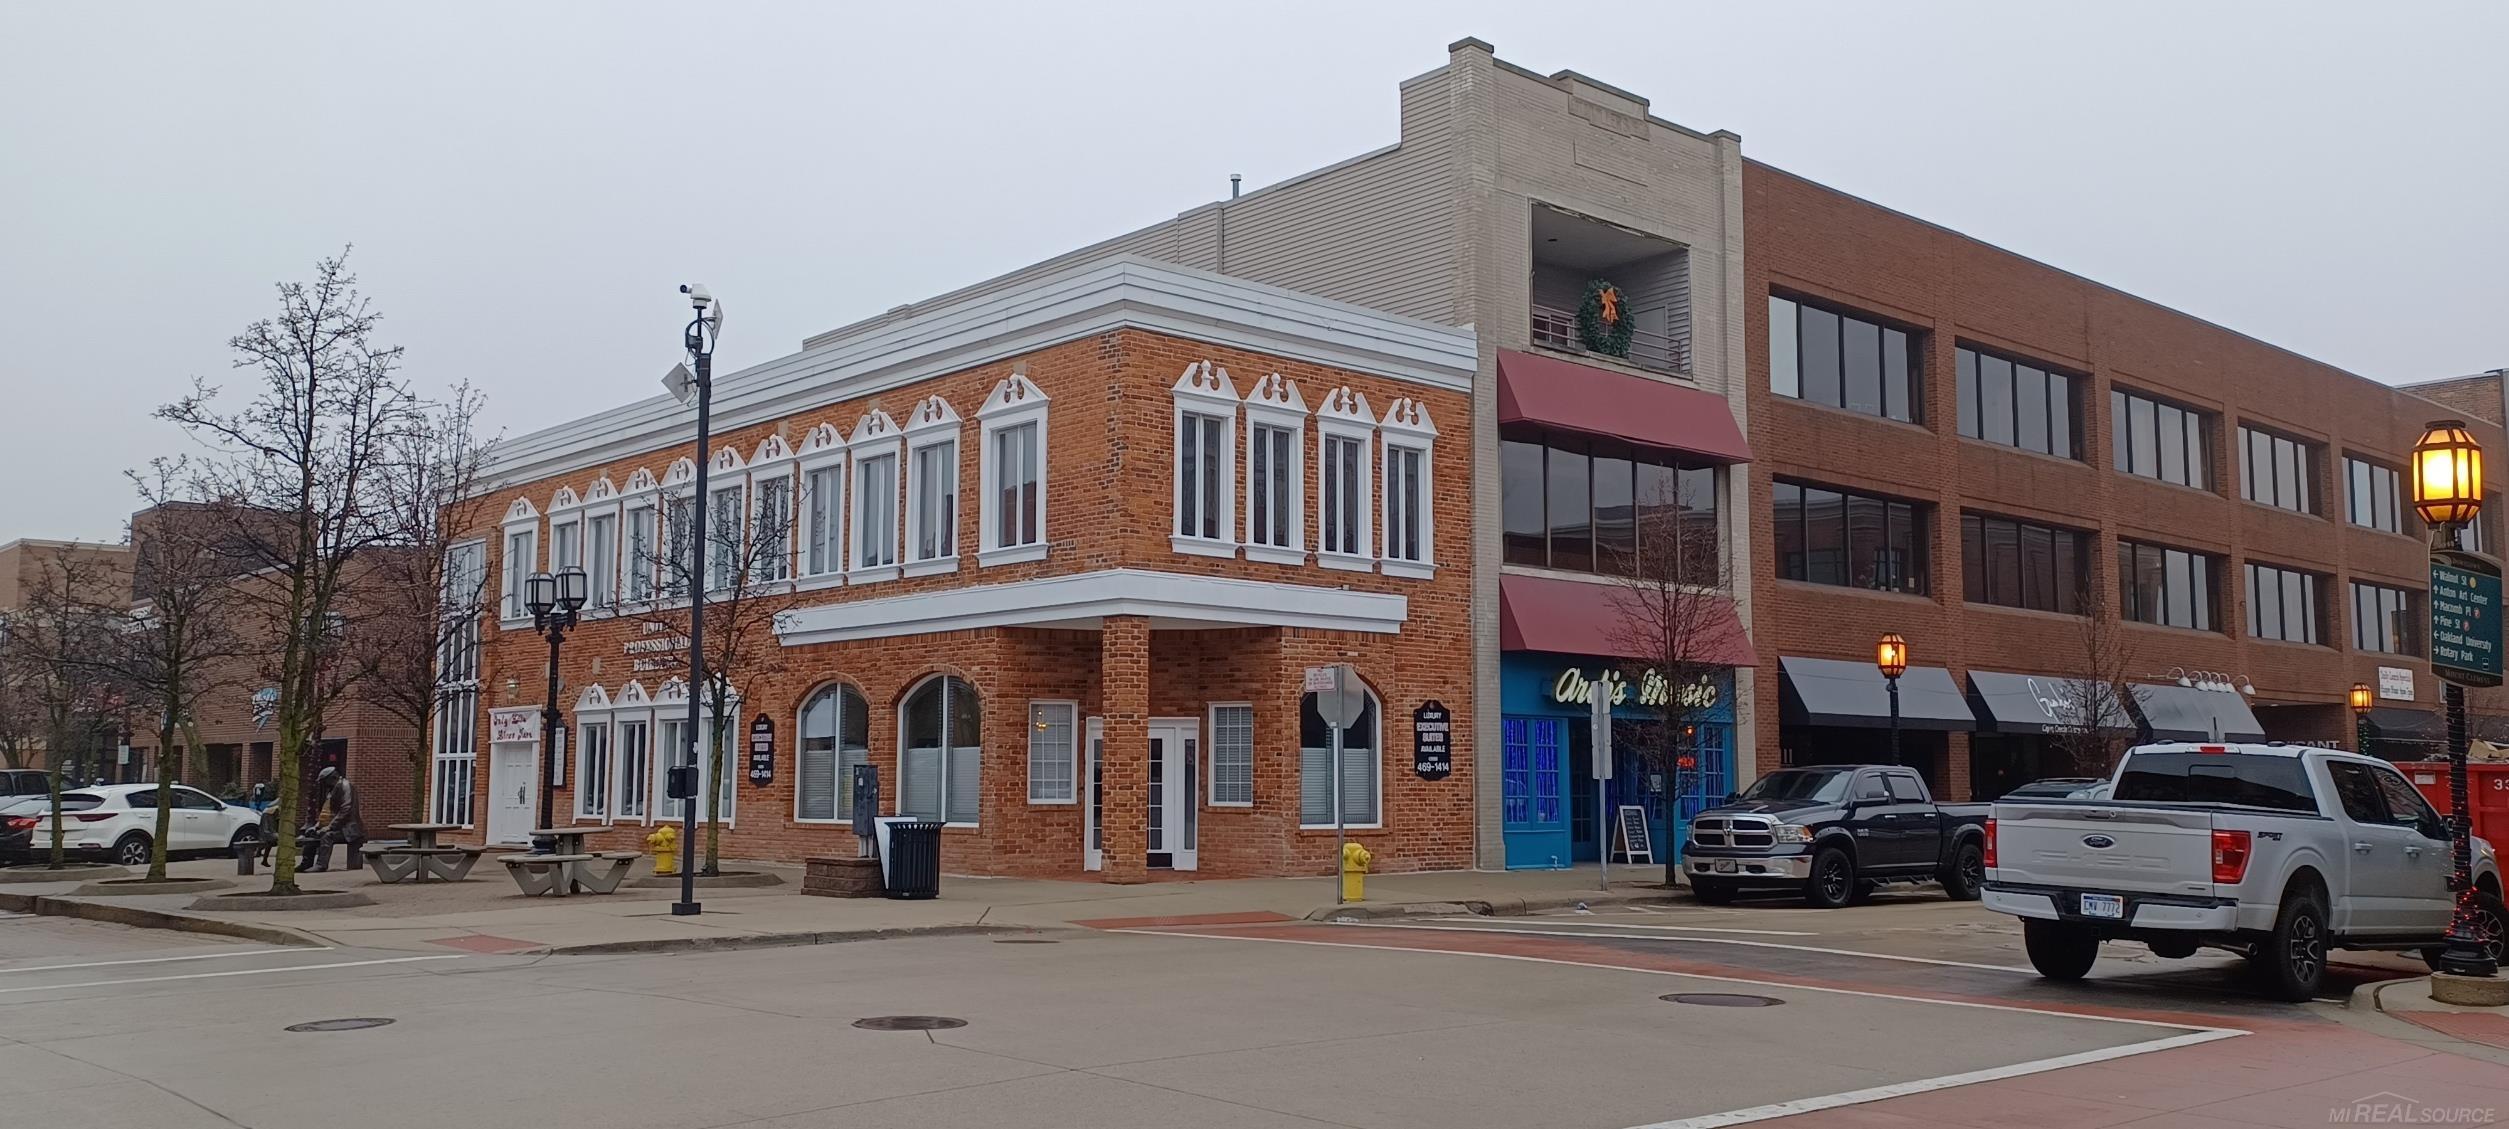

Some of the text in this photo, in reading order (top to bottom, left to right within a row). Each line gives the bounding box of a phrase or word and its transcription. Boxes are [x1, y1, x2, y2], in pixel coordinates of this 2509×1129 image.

[2440, 570, 2467, 586] Walnut St
[2440, 586, 2488, 605] Anton Art Center
[2440, 601, 2462, 615] Macomb
[2440, 616, 2452, 628] Pine
[2455, 619, 2460, 629] St
[2440, 631, 2492, 653] Oakland University
[2440, 646, 2473, 662] Rotary Park
[1416, 722, 1449, 732] EXECUTIVE
[1417, 762, 1449, 772] 469-1414
